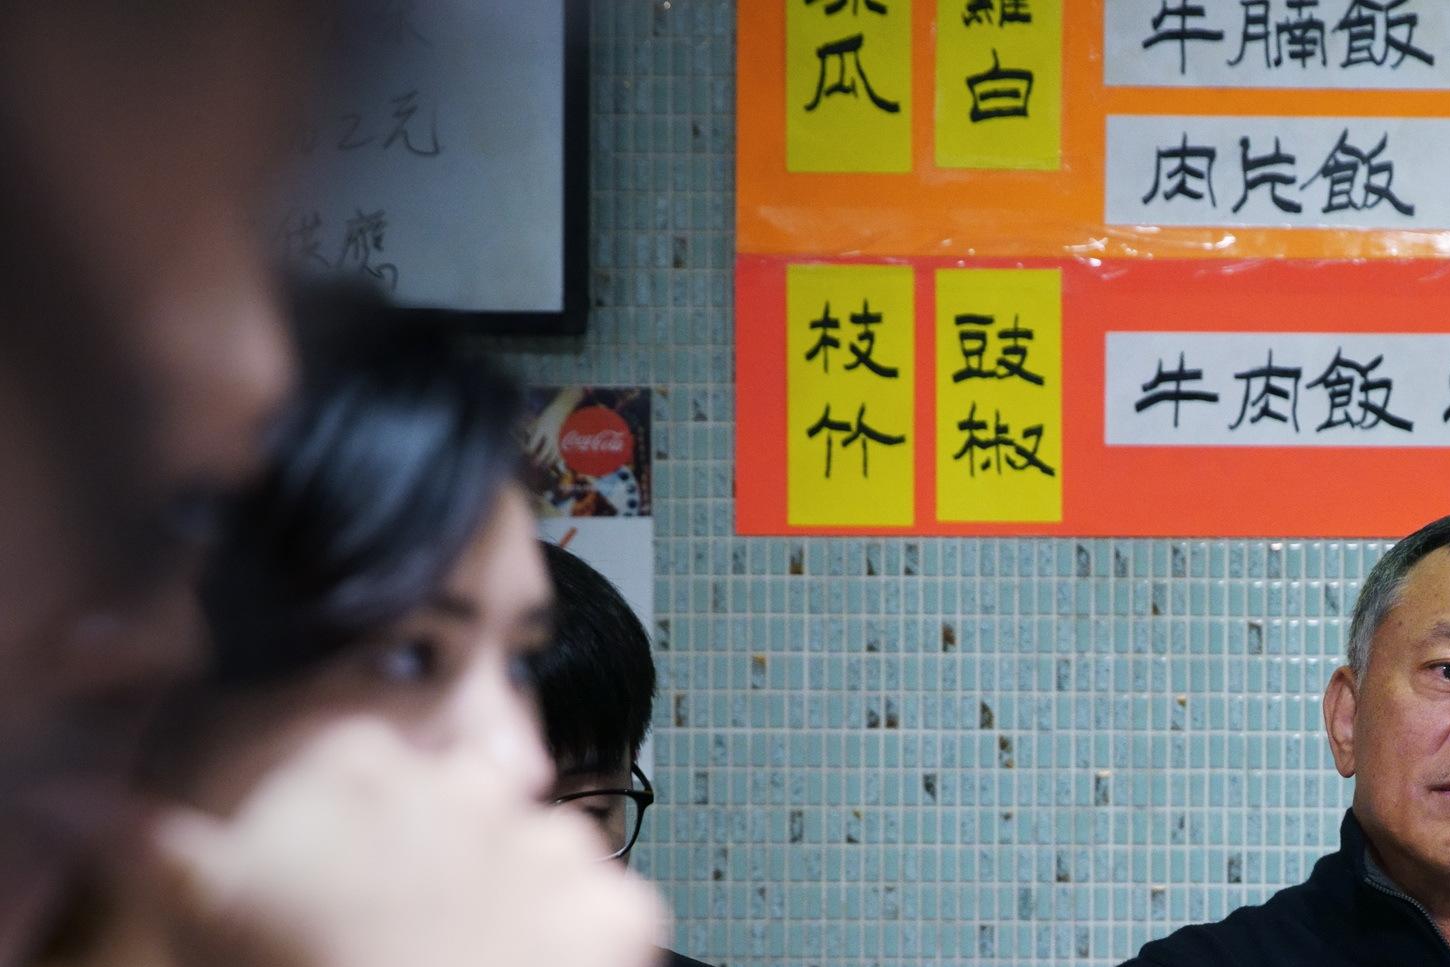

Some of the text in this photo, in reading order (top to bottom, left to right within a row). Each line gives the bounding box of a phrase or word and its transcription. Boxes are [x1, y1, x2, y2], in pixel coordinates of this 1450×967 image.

[804, 0, 901, 114] 瓜
[1142, 0, 1435, 75] 牛腩飯
[1142, 129, 1415, 216] 肉片飯
[805, 297, 906, 478] 枝竹
[952, 312, 1055, 478] 豉椒
[1134, 352, 1414, 432] 牛肉飯
